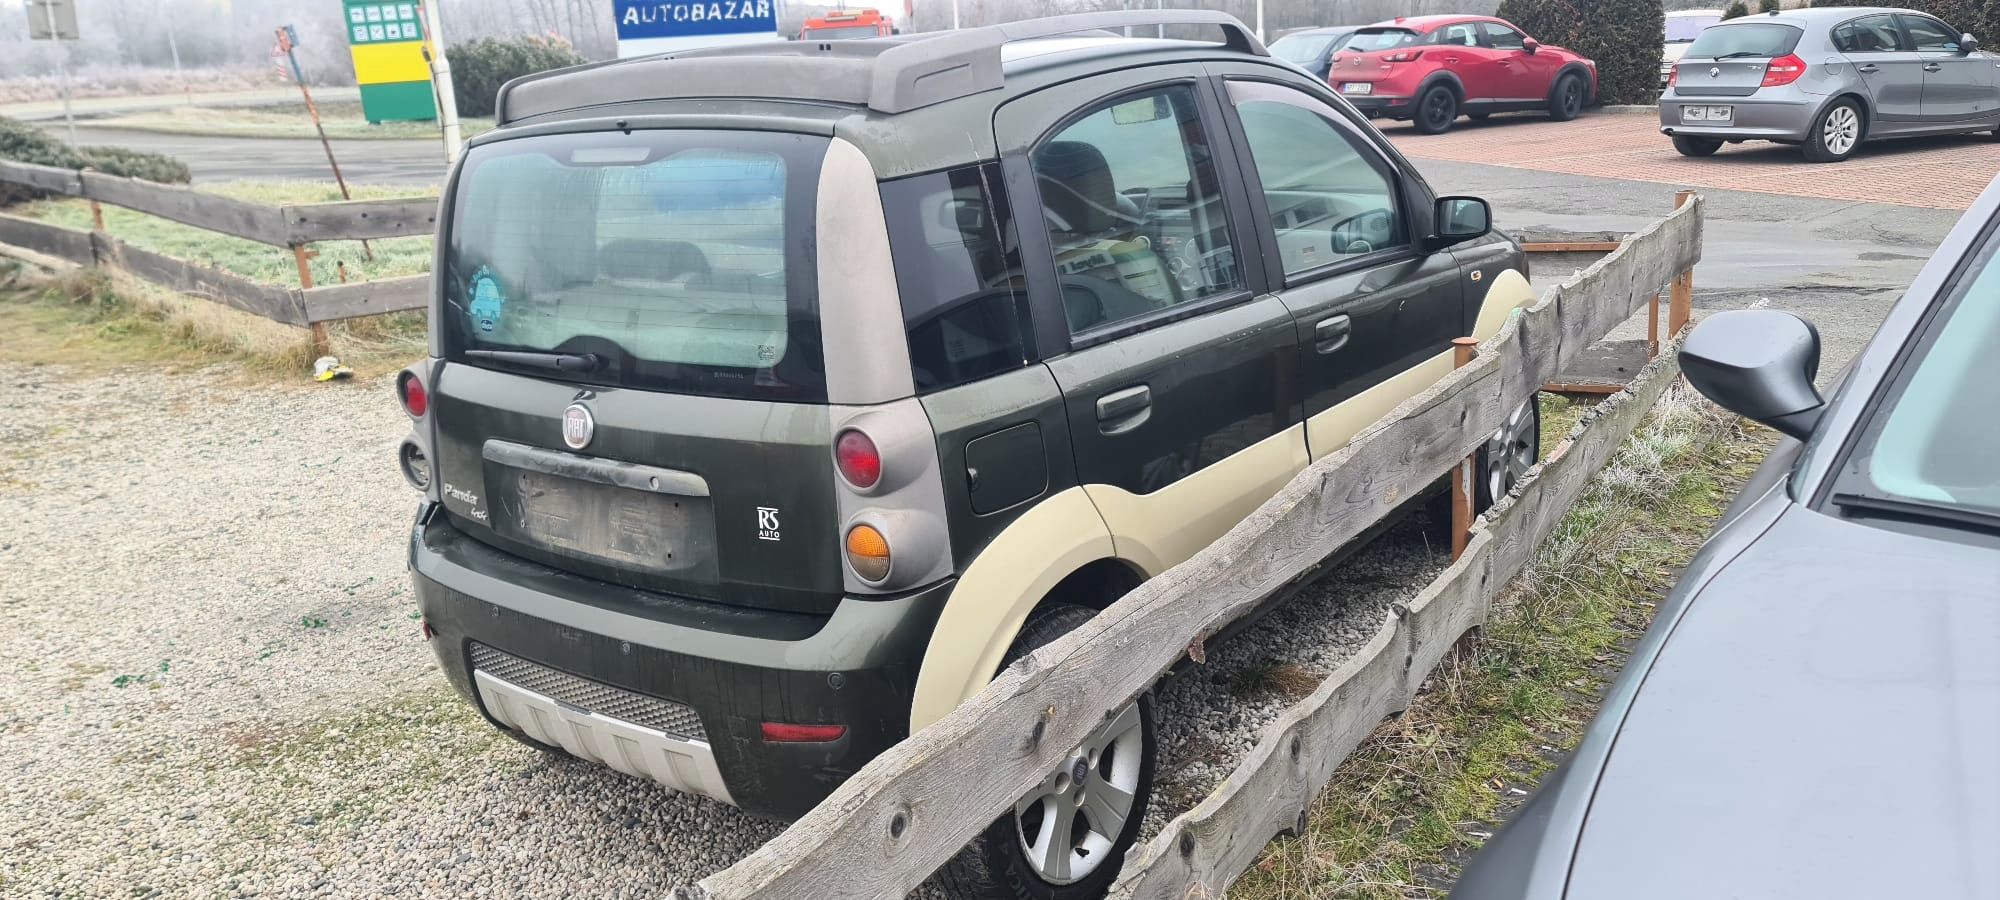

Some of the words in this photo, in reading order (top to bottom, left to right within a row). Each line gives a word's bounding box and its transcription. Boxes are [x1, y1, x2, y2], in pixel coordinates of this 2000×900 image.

[622, 0, 770, 25] AUTOBAZAR
[567, 417, 585, 438] FIAT
[444, 483, 478, 505] Panda
[757, 509, 779, 530] RS
[759, 530, 780, 538] AUTO
